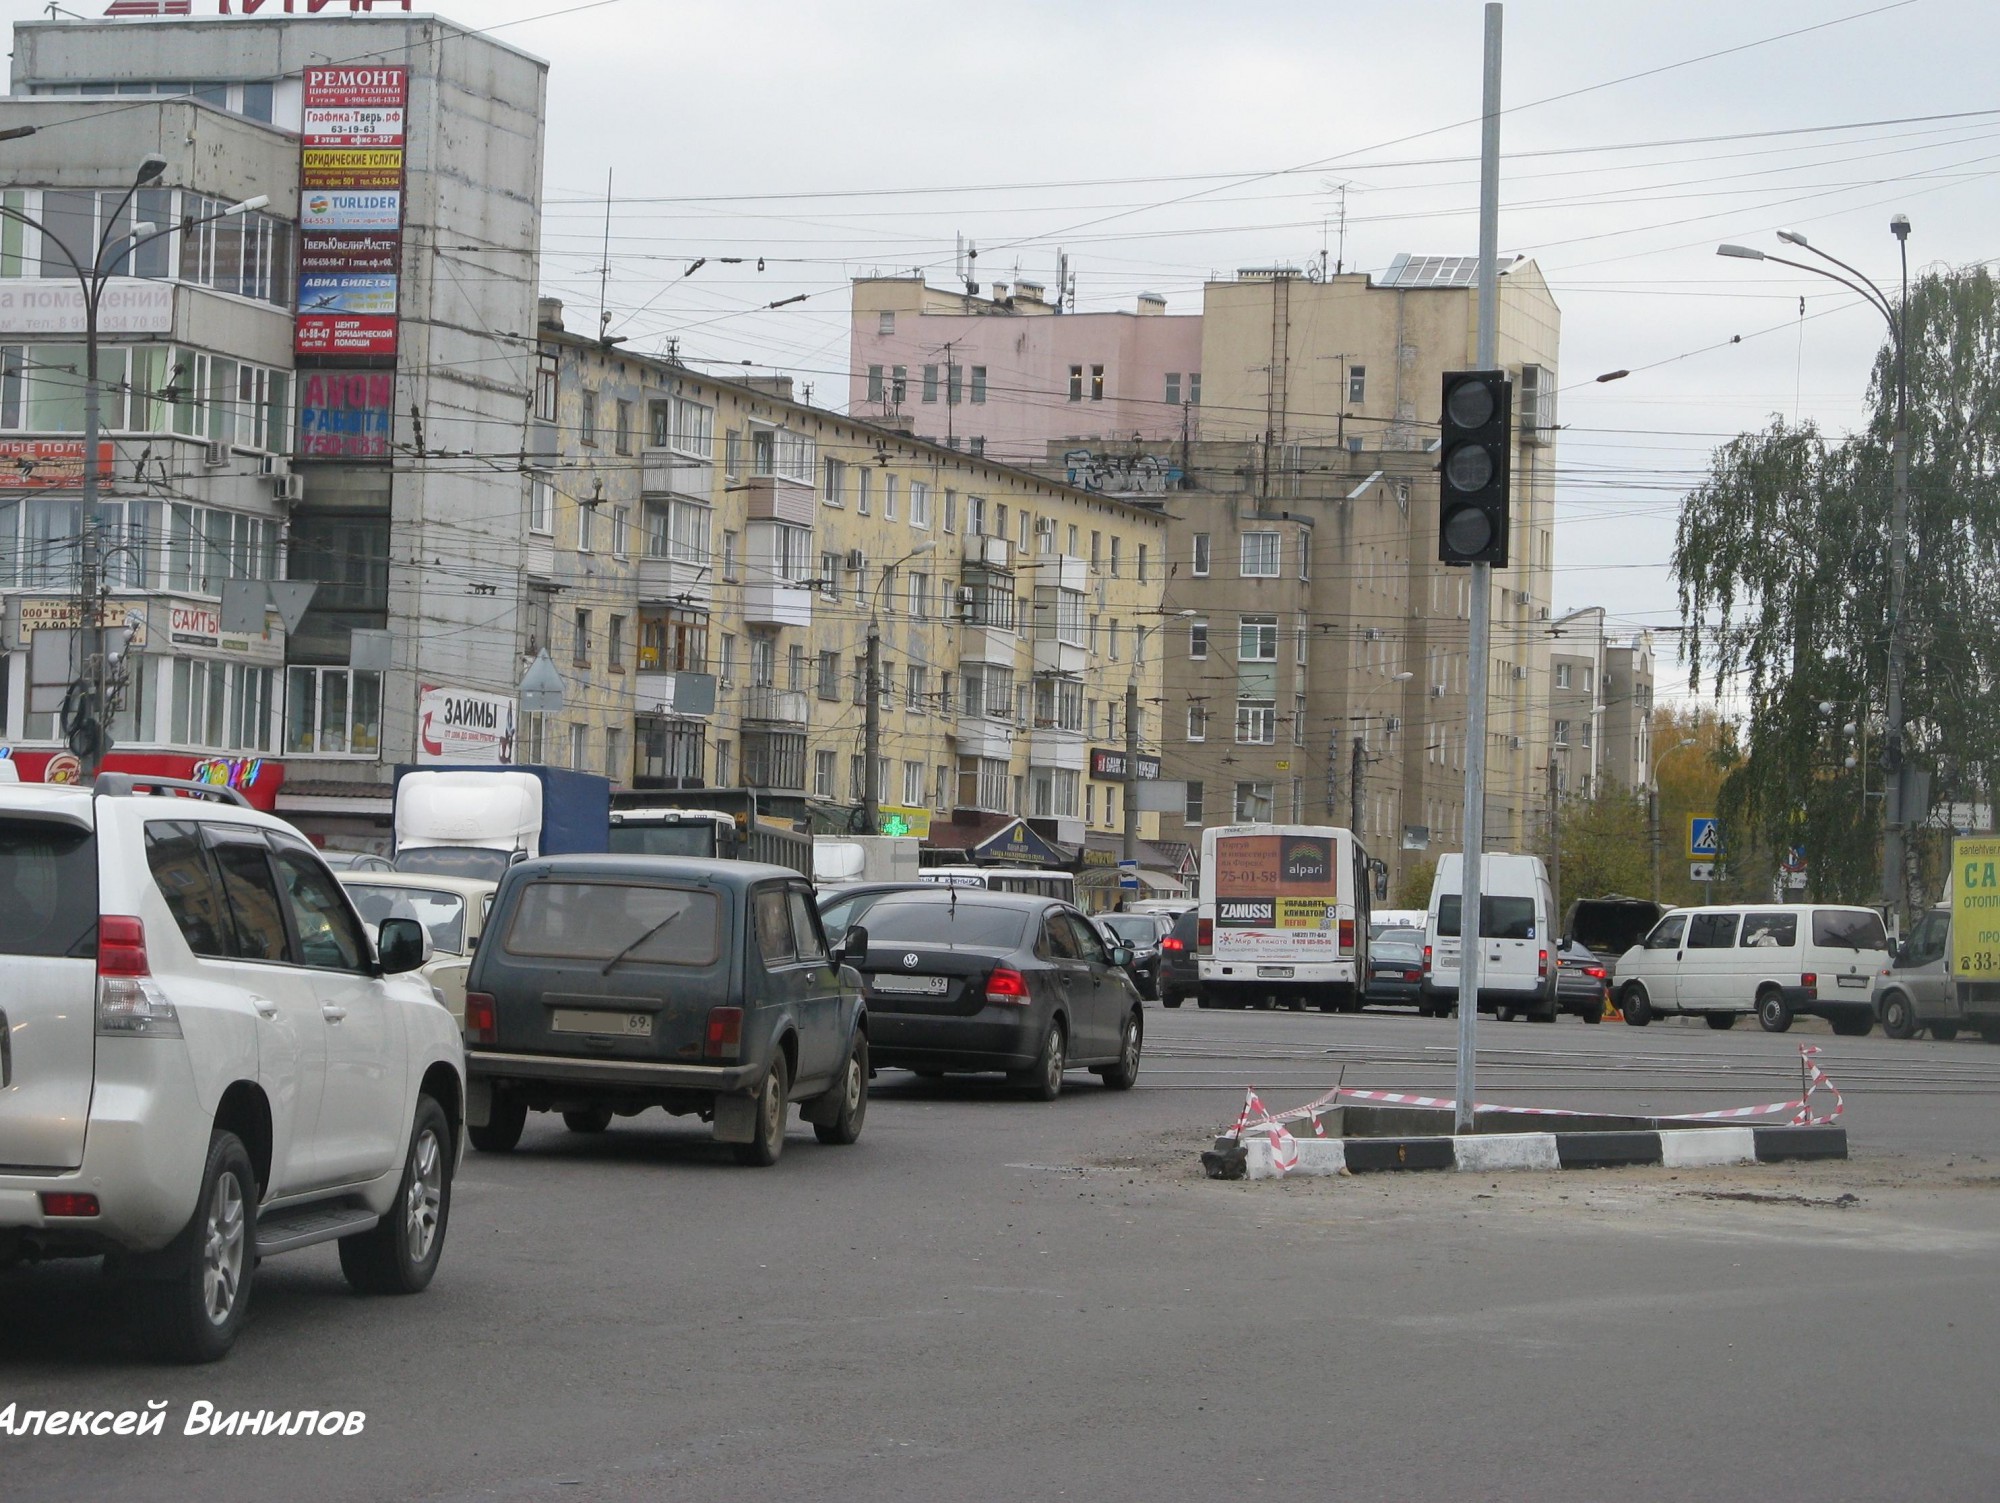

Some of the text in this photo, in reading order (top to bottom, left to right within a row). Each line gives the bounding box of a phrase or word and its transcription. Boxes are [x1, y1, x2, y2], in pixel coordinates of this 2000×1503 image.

[310, 71, 402, 86] РЕМОНТ
[309, 87, 357, 95] ЦИФРОВОЙ
[331, 125, 375, 133] 63-19-63
[313, 135, 319, 143] 3
[350, 135, 372, 145] офис
[305, 153, 400, 166] ЮРИДИЧЕСКИЕ УСЛУГИ
[332, 196, 396, 208] TURLIDER
[305, 278, 391, 287] АВИА БИЛЕТЫ
[59, 319, 66, 328] 8
[103, 317, 127, 328] 934
[132, 317, 146, 328] 70
[152, 317, 167, 328] 89
[335, 321, 360, 329] ЦЕНТР
[335, 329, 392, 338] ЮРИДИЧЕСКОЙ
[334, 339, 370, 347] ПОМОЩИ
[304, 374, 390, 408] AVON
[302, 408, 388, 432] РАБОТА
[172, 606, 219, 634] САЙТЫ
[445, 698, 497, 728] ЗАЙМЫ
[1289, 864, 1323, 876] alpari
[1221, 871, 1277, 882] 75-01-58
[1963, 896, 2000, 908] ОТОПЛ
[1221, 903, 1272, 918] ZANUSSI
[1284, 909, 1325, 917] КЛИМАТОМ
[1327, 906, 1335, 918] 8
[1527, 928, 1534, 937] 2
[1973, 952, 2000, 970] 33-
[930, 978, 944, 987] 69
[629, 1016, 646, 1028] 69
